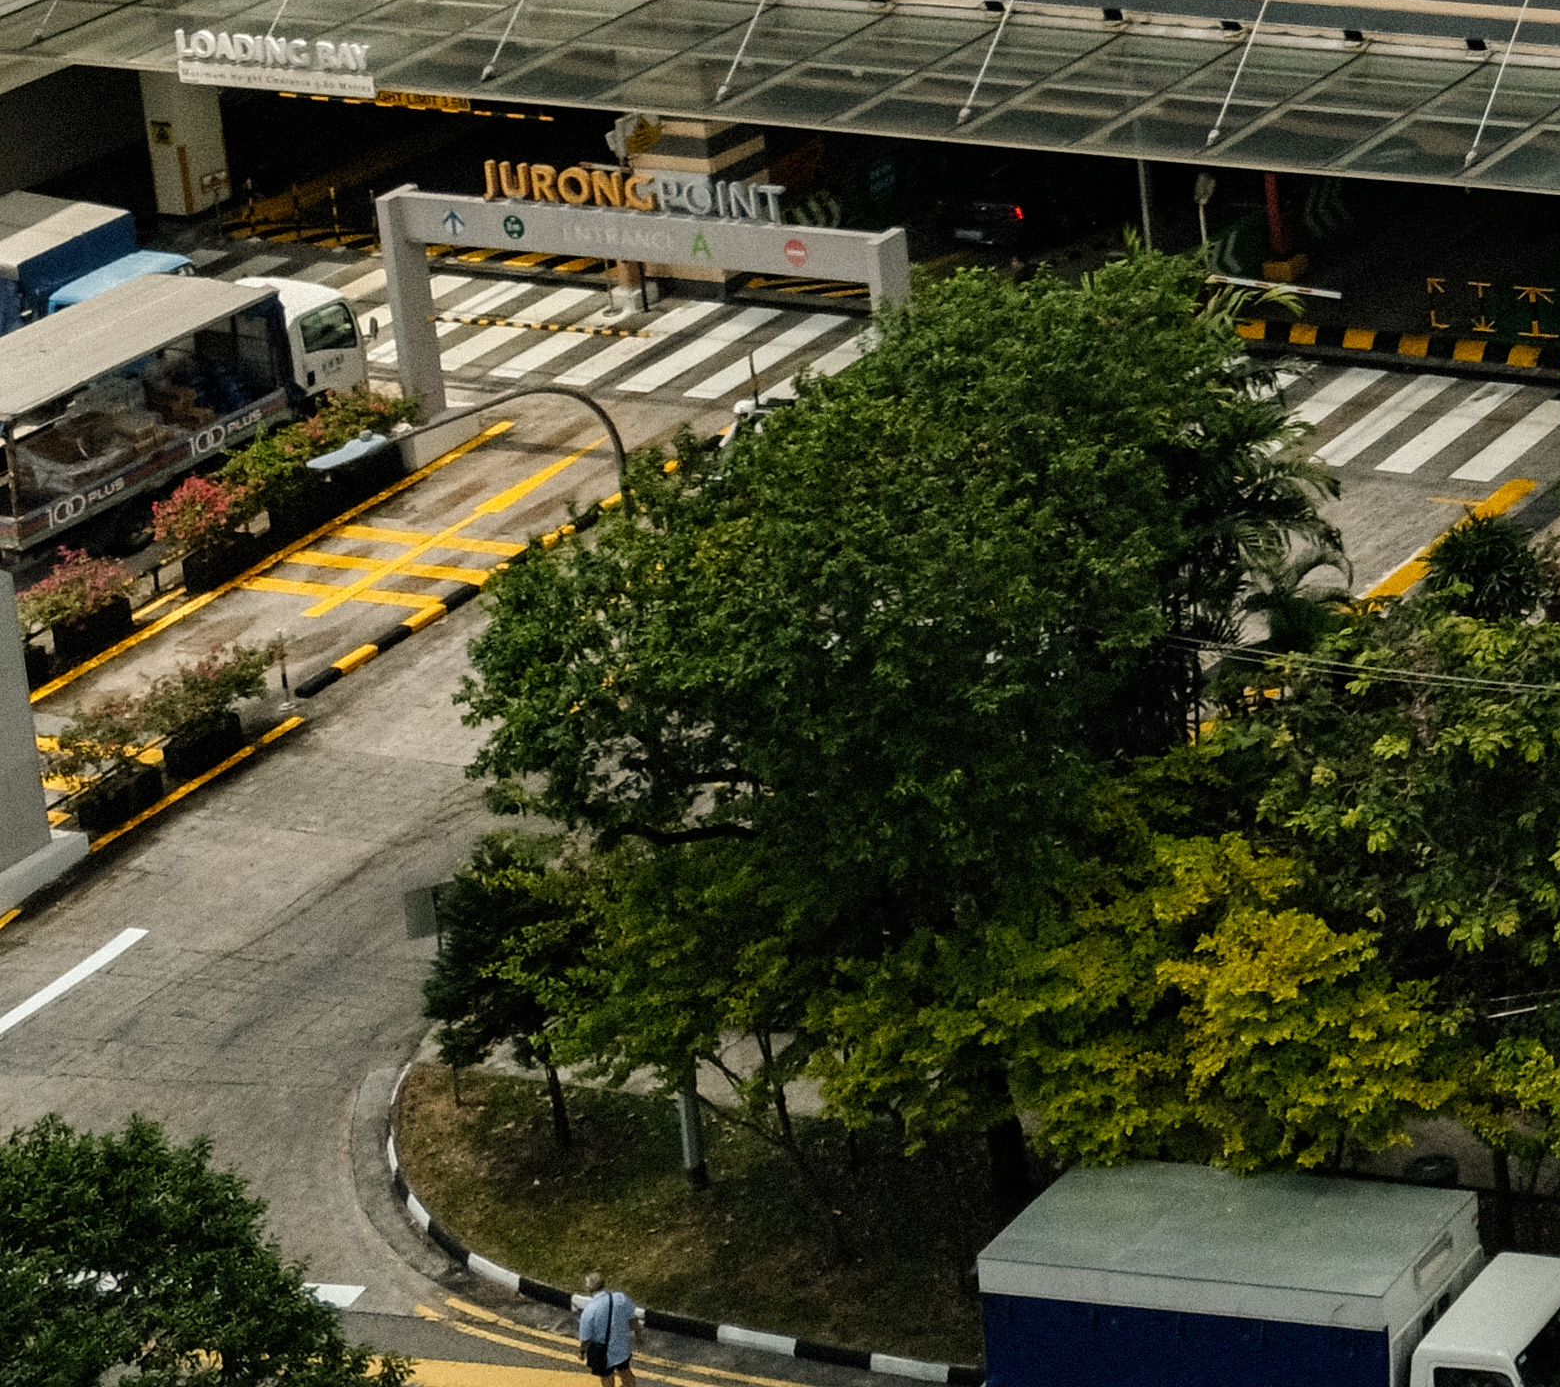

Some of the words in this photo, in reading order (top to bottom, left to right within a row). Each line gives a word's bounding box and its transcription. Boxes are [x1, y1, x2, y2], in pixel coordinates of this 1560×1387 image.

[175, 29, 307, 68] LOADING
[315, 40, 370, 71] BAY
[691, 233, 712, 258] A
